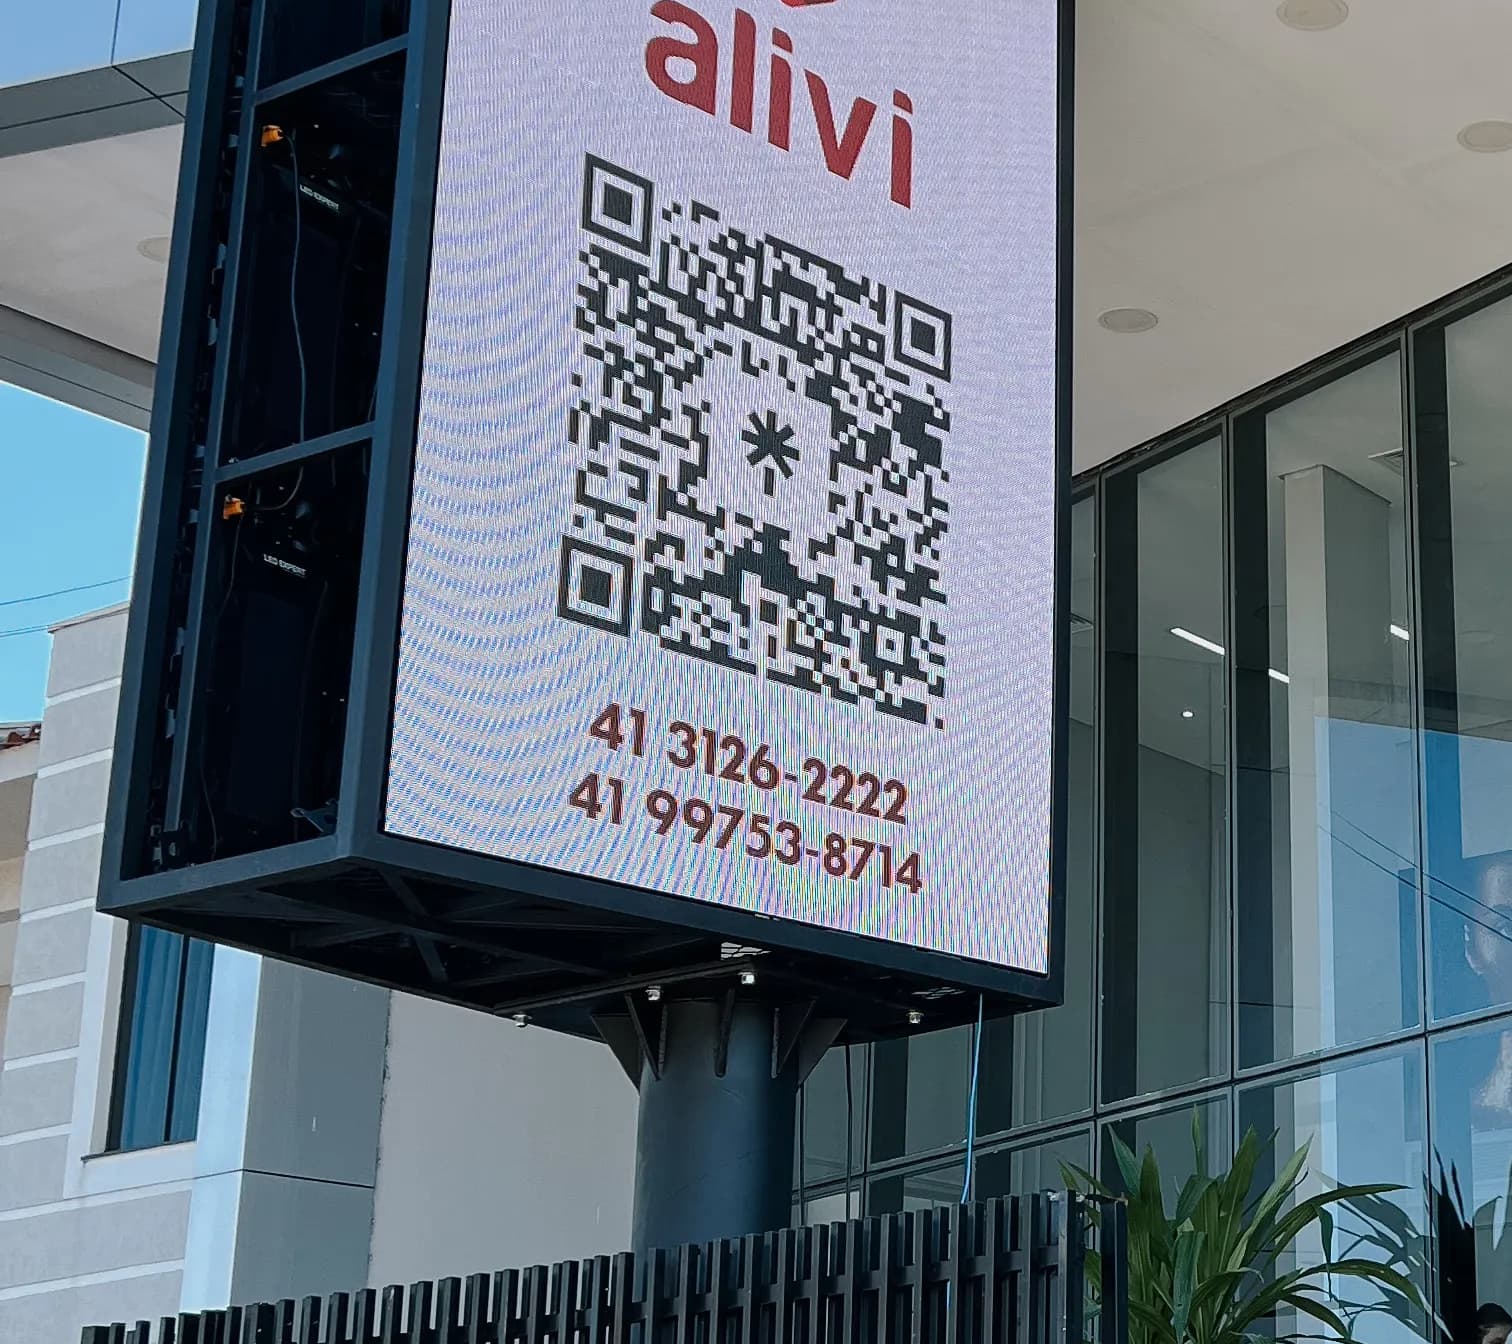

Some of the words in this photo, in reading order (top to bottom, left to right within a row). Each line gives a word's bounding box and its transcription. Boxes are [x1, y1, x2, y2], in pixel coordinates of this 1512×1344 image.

[264, 554, 278, 565] LED
[589, 702, 647, 757] 41
[667, 720, 908, 825] 3126-2222
[568, 771, 625, 825] 41
[646, 789, 924, 895] 99753-8714
